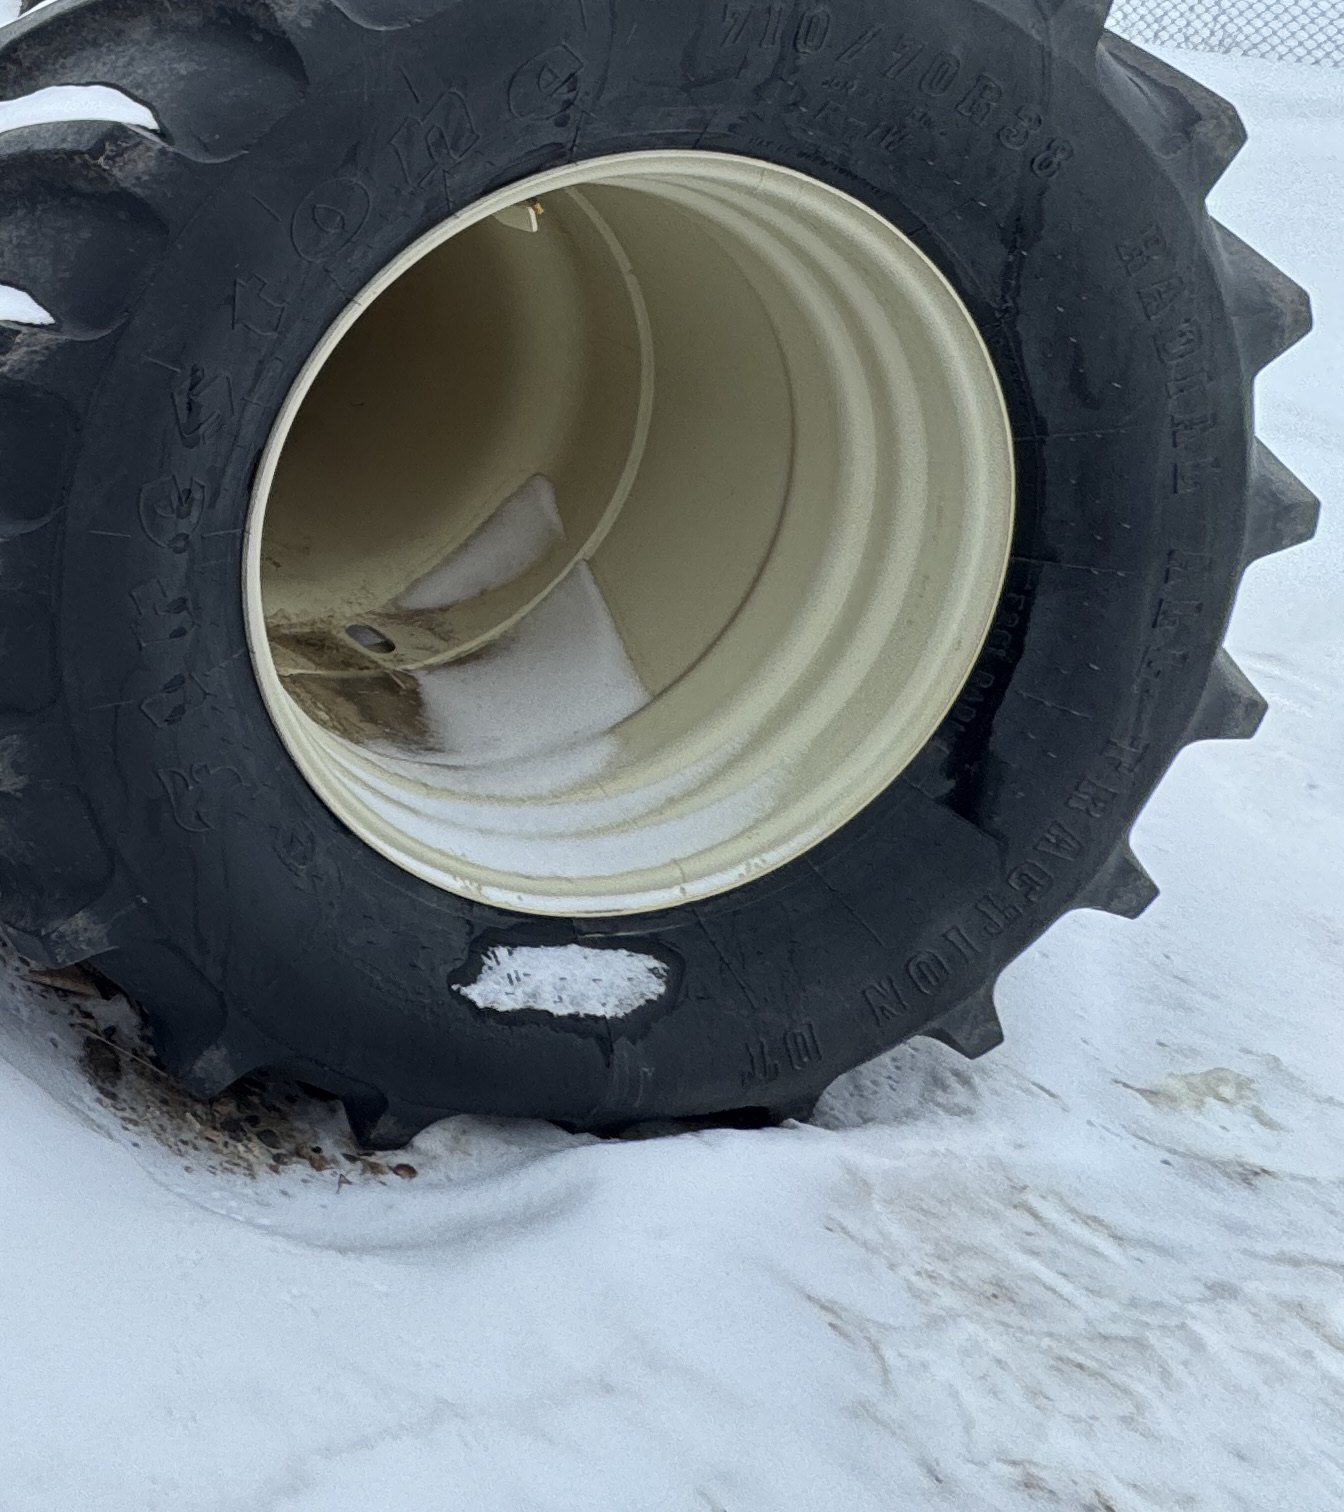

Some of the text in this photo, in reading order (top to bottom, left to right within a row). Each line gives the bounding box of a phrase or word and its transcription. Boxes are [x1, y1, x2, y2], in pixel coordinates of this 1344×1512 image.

[718, 2, 1076, 181] 710/70R38
[1115, 222, 1220, 496] RADIAL
[860, 735, 1150, 1028] TRACTION
